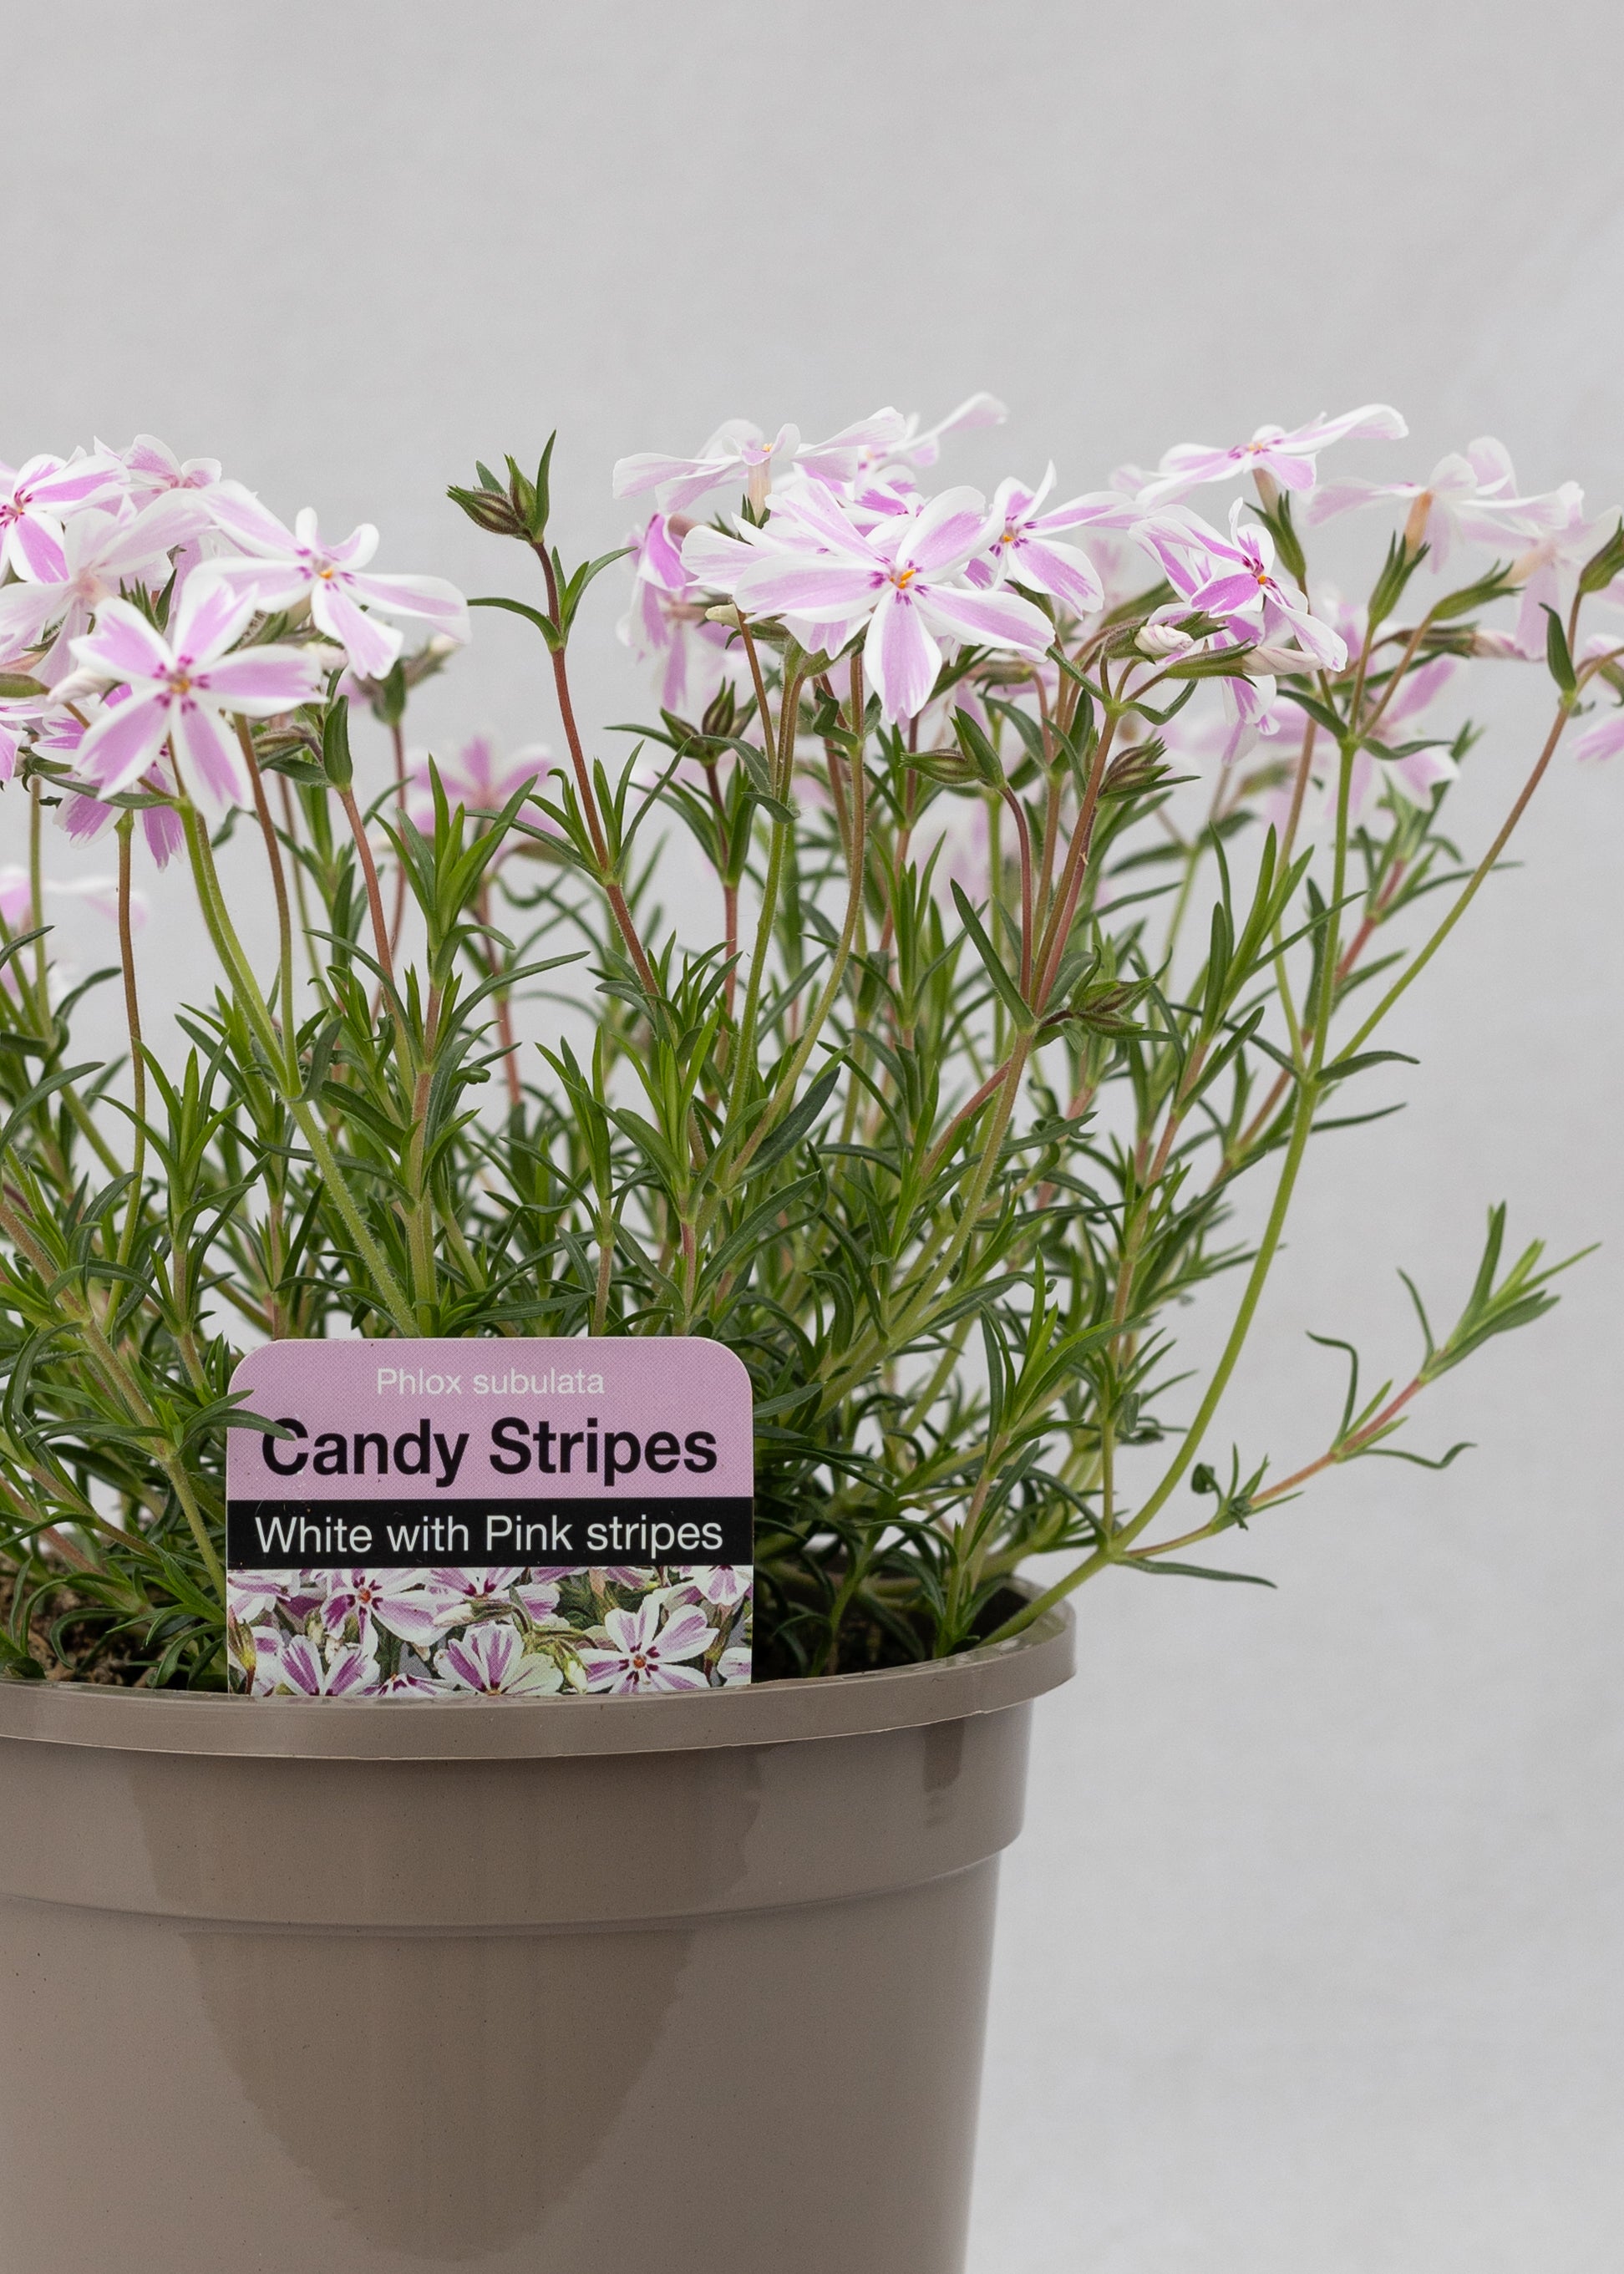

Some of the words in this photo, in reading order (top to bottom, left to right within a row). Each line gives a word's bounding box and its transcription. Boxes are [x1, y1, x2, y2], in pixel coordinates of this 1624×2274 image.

[377, 1368, 462, 1395] Phlox
[473, 1368, 605, 1395] subulata
[261, 1417, 469, 1488] Candy
[489, 1417, 718, 1487] Stripes
[255, 1516, 373, 1553] White
[386, 1515, 469, 1552] with
[486, 1515, 573, 1551] Pink
[586, 1514, 723, 1560] stripes
